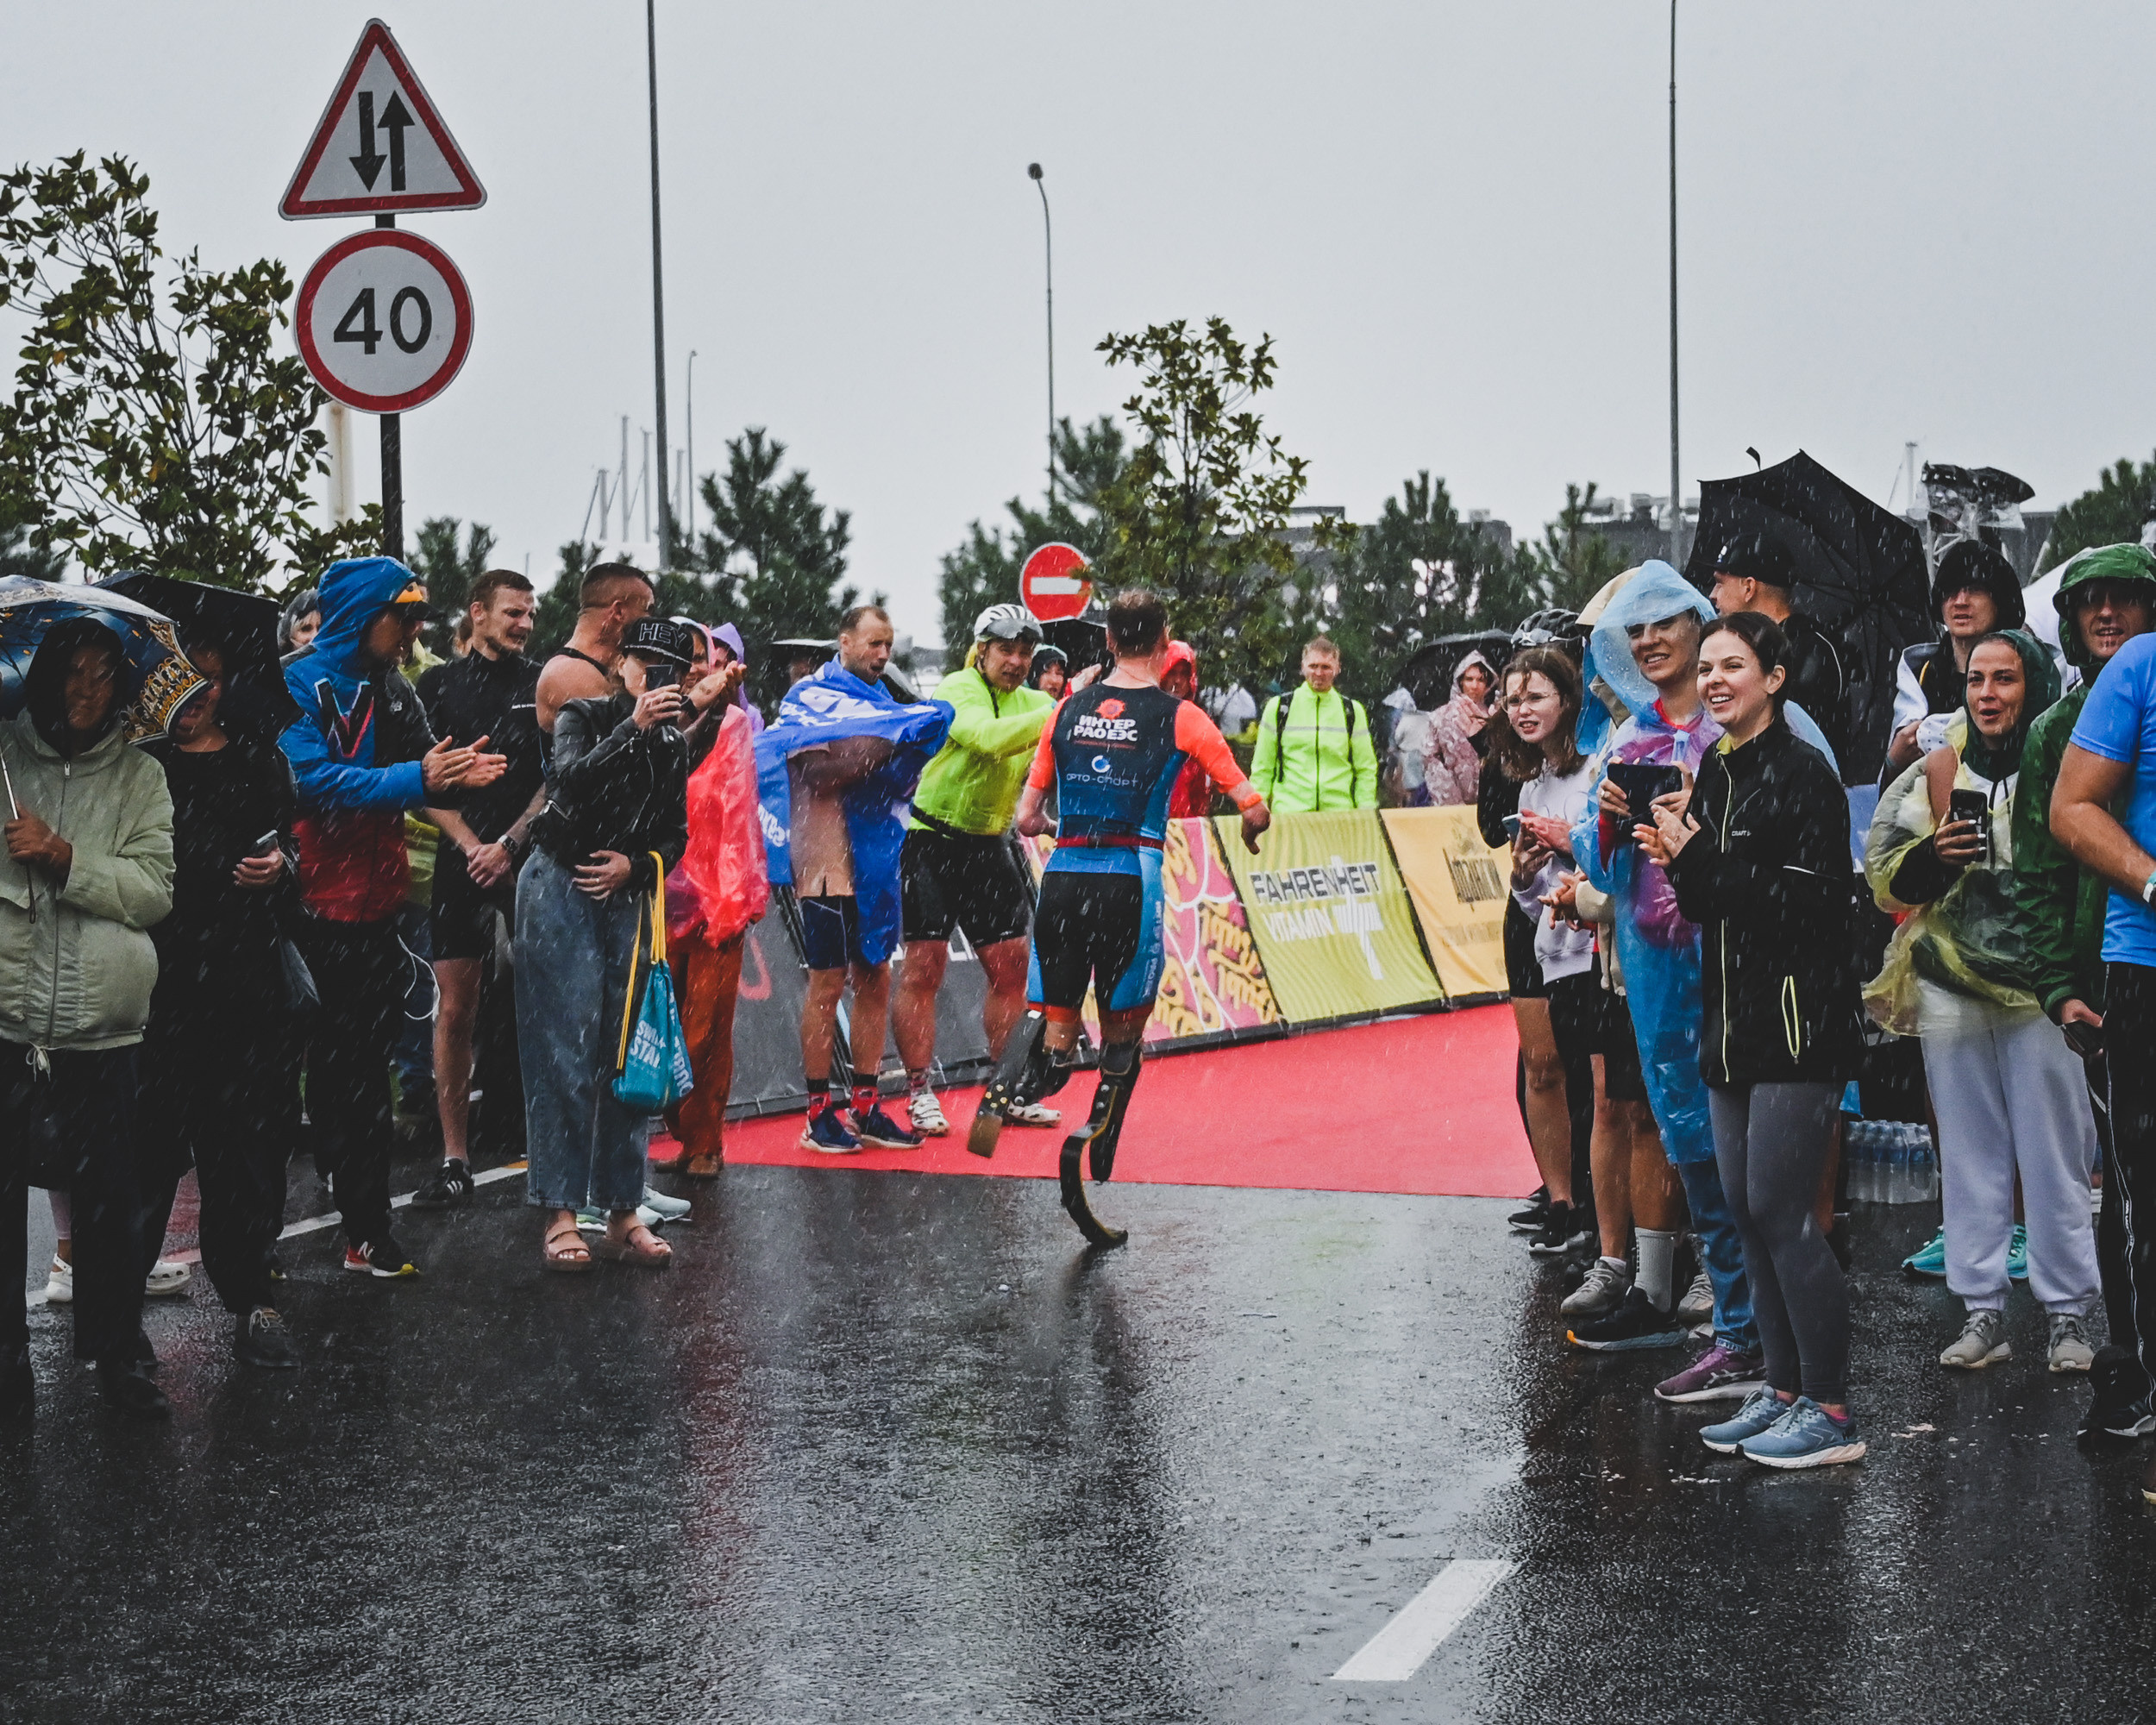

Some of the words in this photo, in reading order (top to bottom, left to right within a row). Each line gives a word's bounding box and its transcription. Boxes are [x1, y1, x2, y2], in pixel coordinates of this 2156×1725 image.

[334, 285, 432, 354] 40
[639, 623, 686, 649] HEY
[1079, 714, 1136, 730] ИНТЕР
[1250, 863, 1380, 904] FAHRENHEIT
[1263, 906, 1335, 942] VITAMIN
